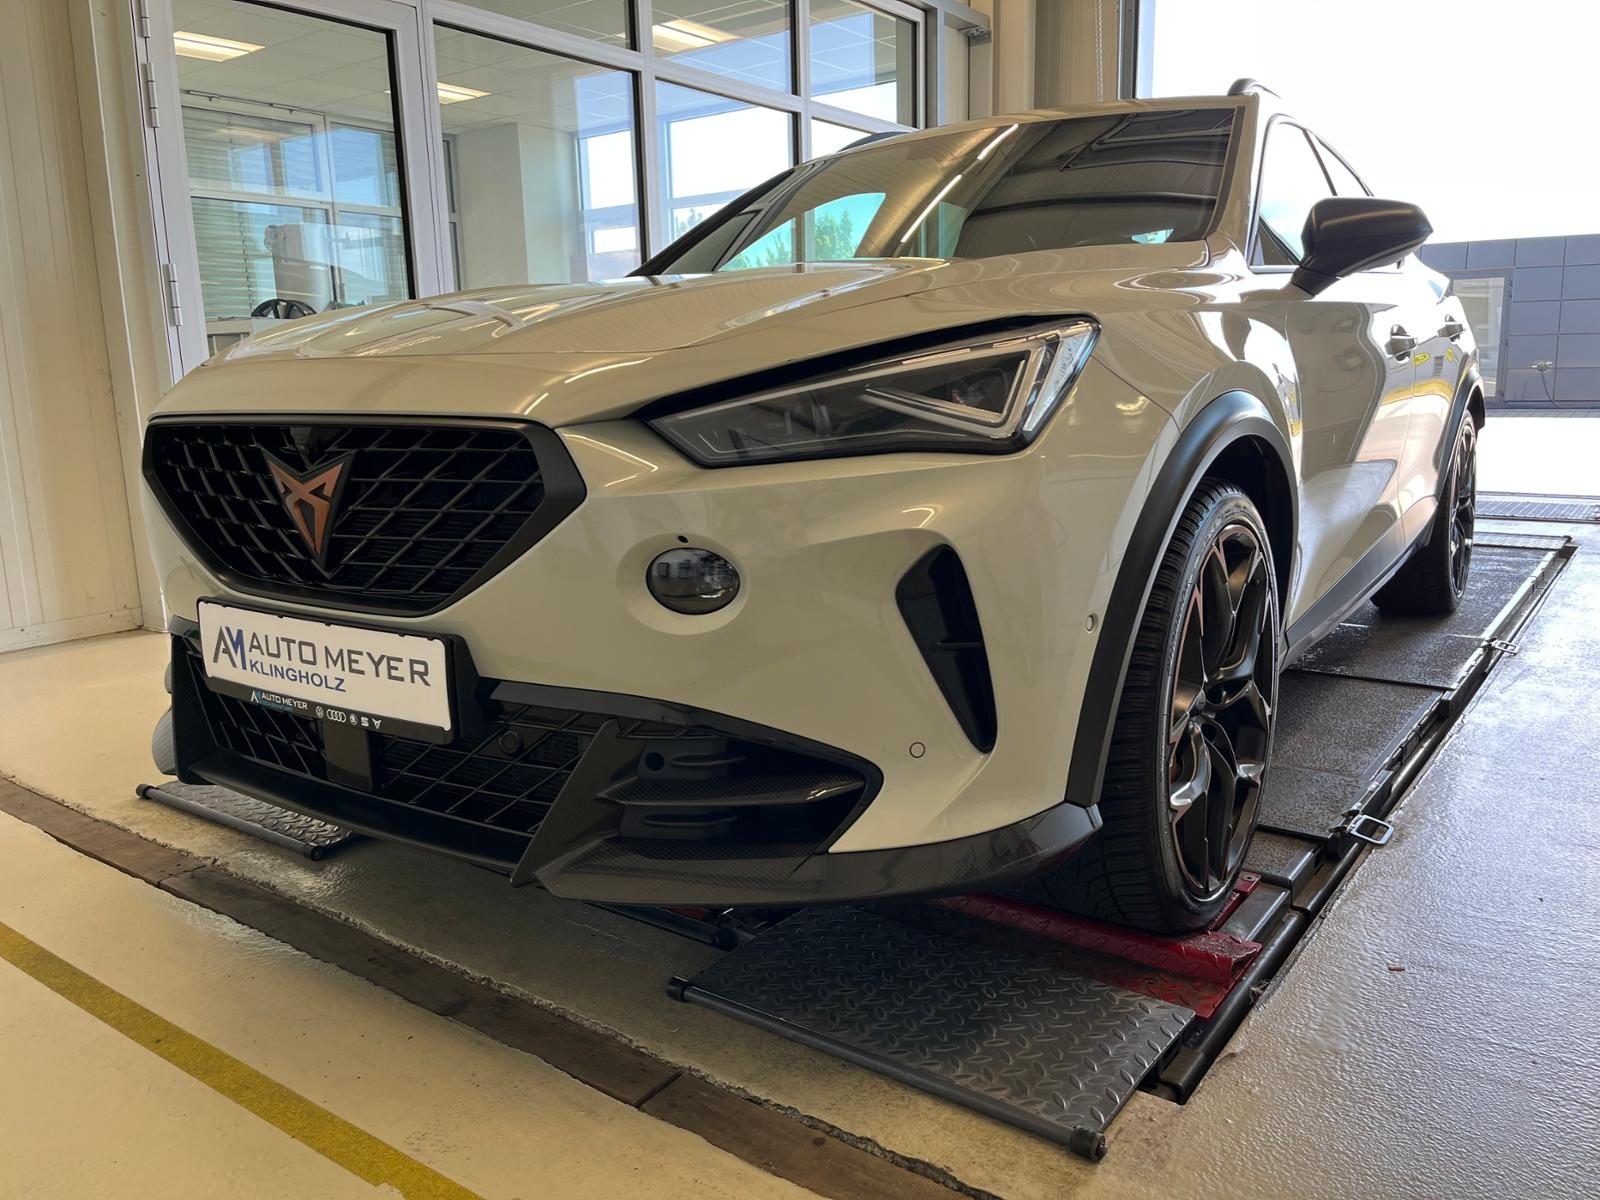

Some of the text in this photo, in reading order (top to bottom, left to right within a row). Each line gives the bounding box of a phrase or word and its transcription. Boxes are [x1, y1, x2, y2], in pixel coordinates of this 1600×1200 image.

[249, 632, 317, 666] AUTO
[325, 646, 431, 686] MEYER
[250, 660, 346, 692] KLINGHOLZ
[261, 692, 281, 704] AUTO
[282, 696, 308, 710] MEYER
